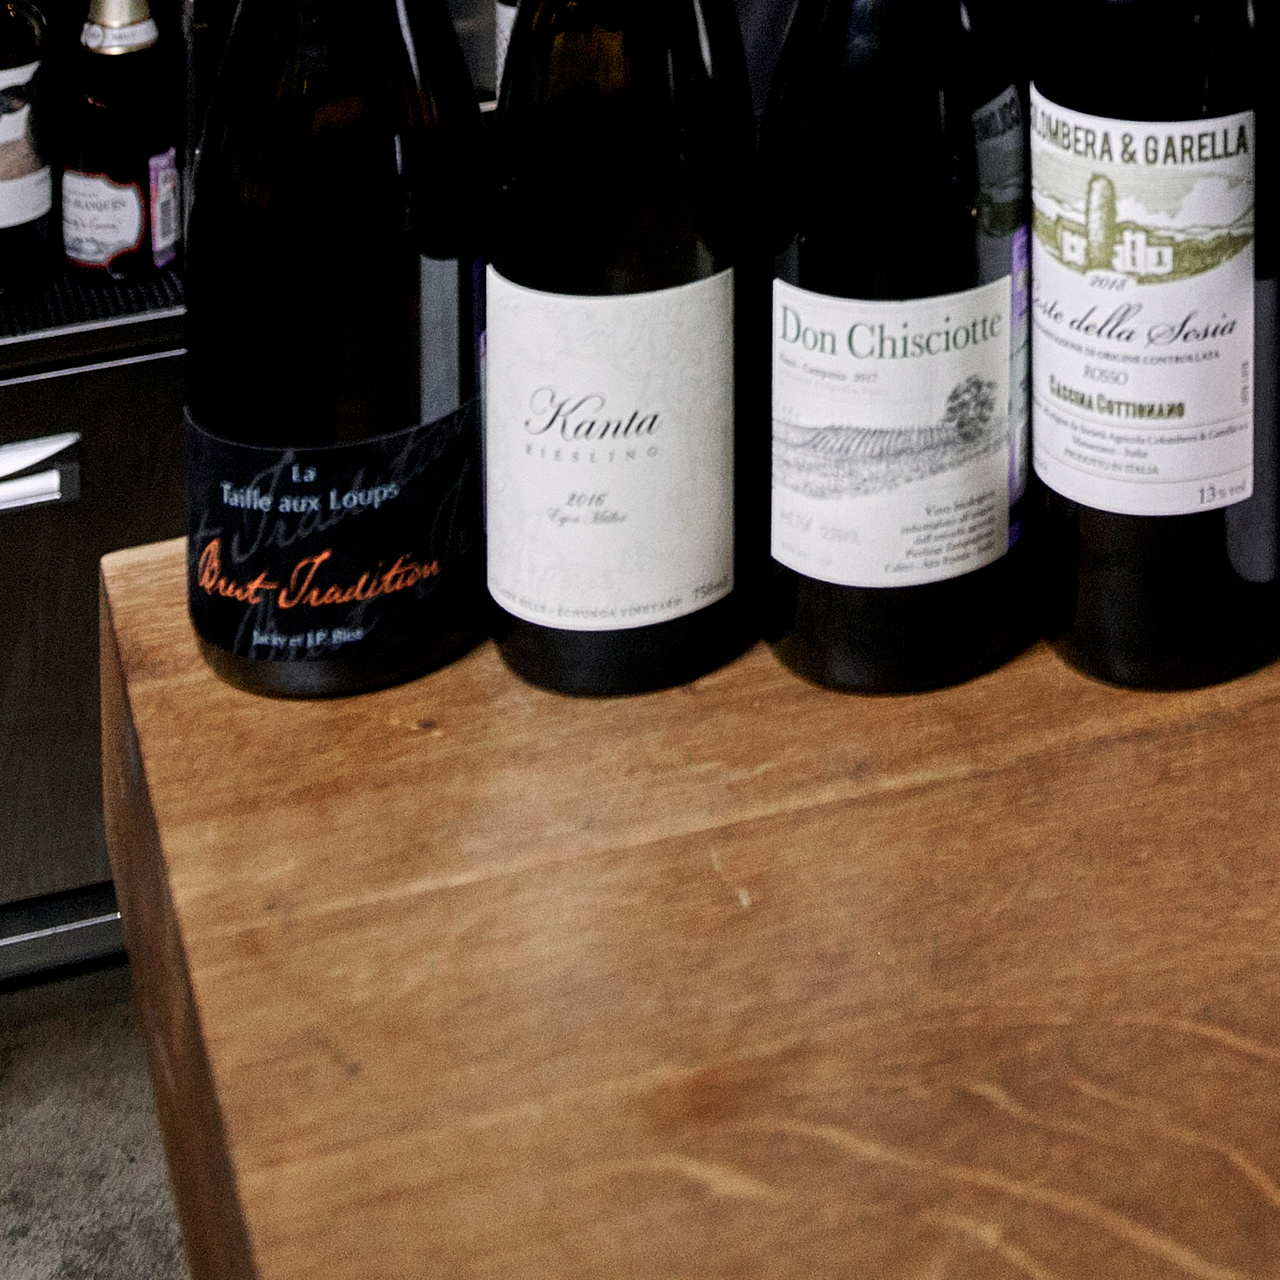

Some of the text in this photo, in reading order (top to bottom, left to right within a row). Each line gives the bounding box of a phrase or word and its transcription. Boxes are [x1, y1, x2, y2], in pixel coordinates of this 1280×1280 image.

[1120, 131, 1137, 164] &
[1145, 124, 1250, 165] GARELLA
[780, 304, 837, 356] Don
[848, 312, 1002, 359] Chisciotte
[1069, 301, 1143, 342] della
[1147, 308, 1238, 347] Sesia
[1083, 365, 1129, 386] ROSSO
[524, 387, 661, 442] Kanta
[291, 463, 318, 483] La
[525, 443, 659, 465] RIESLING
[220, 479, 400, 514] Taille aux Loups
[199, 537, 279, 604] Brut
[277, 547, 442, 610] Tradition
